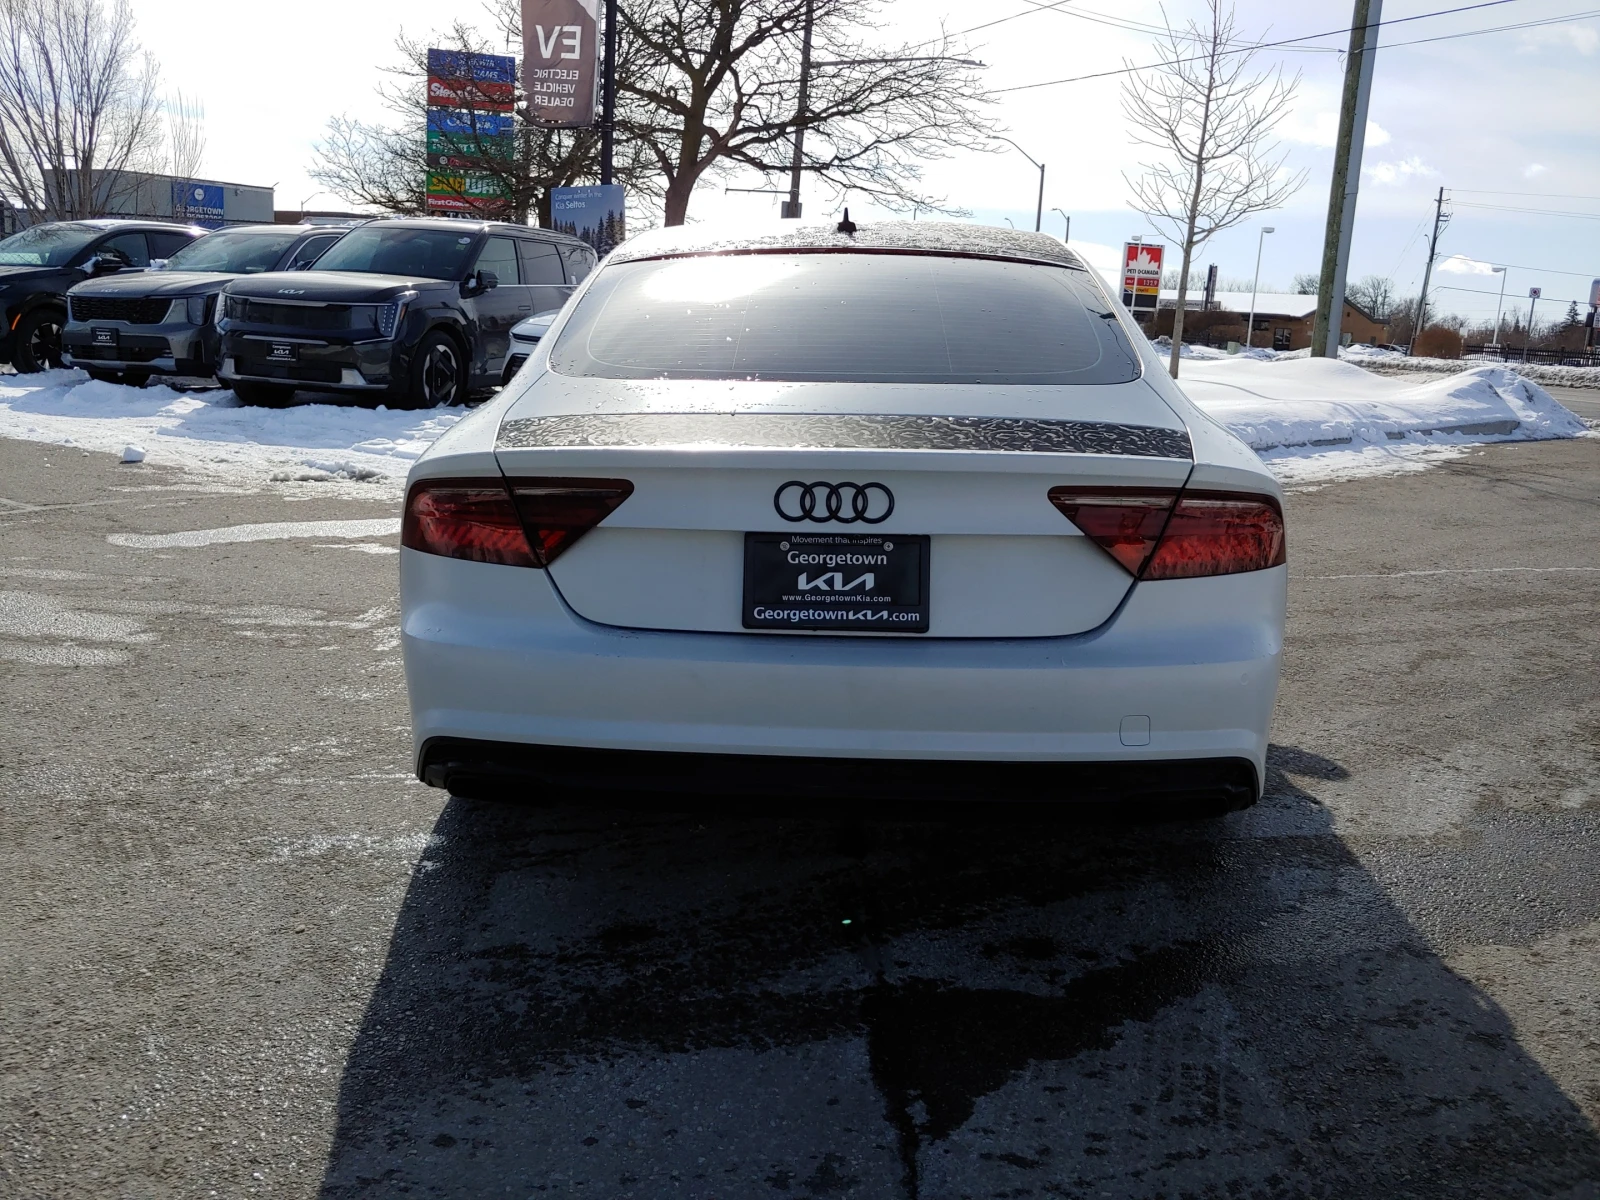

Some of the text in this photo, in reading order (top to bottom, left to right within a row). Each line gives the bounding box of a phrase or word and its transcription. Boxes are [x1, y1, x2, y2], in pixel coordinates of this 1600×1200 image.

[458, 58, 495, 67] SERWIN
[555, 201, 586, 210] Kia Seltos
[791, 535, 883, 546] Movement that inspires
[787, 550, 887, 568] Georgetown
[797, 571, 875, 591] KIA
[781, 593, 892, 603] www.GeorgetownKia.com
